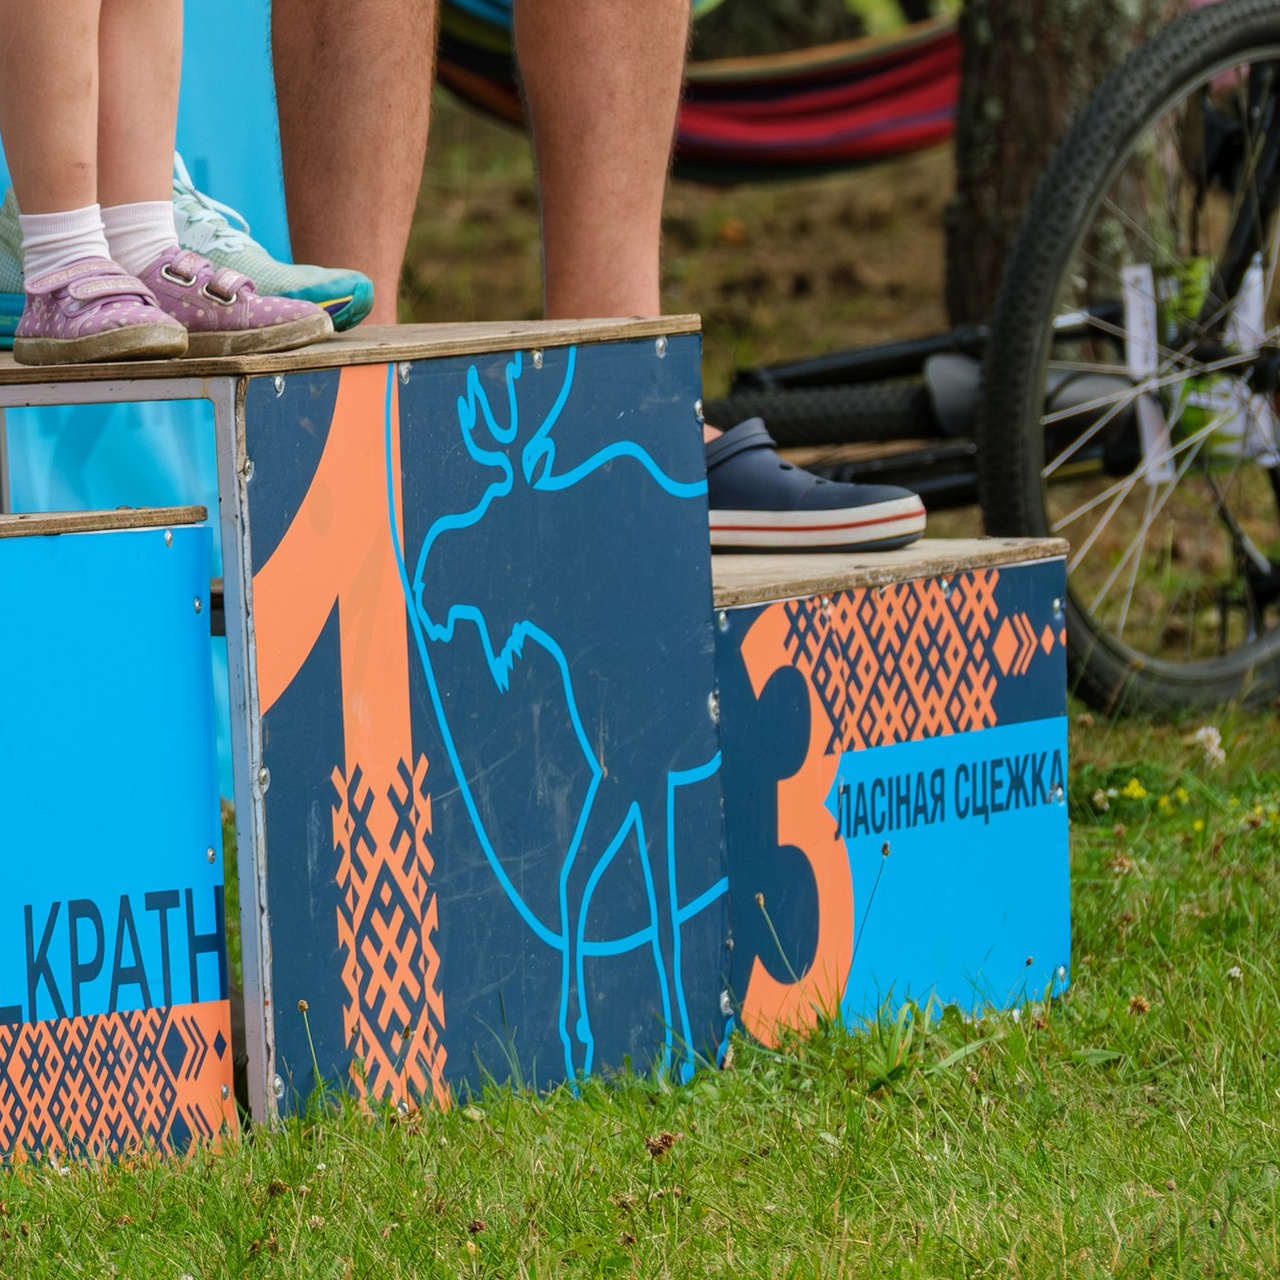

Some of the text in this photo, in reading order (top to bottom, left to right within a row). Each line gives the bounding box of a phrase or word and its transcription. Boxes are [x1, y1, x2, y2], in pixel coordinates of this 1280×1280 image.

[252, 362, 452, 1112] 1
[741, 598, 856, 1049] 3
[834, 749, 1065, 842] ЛАСІНАЯ СЦЕЖКА
